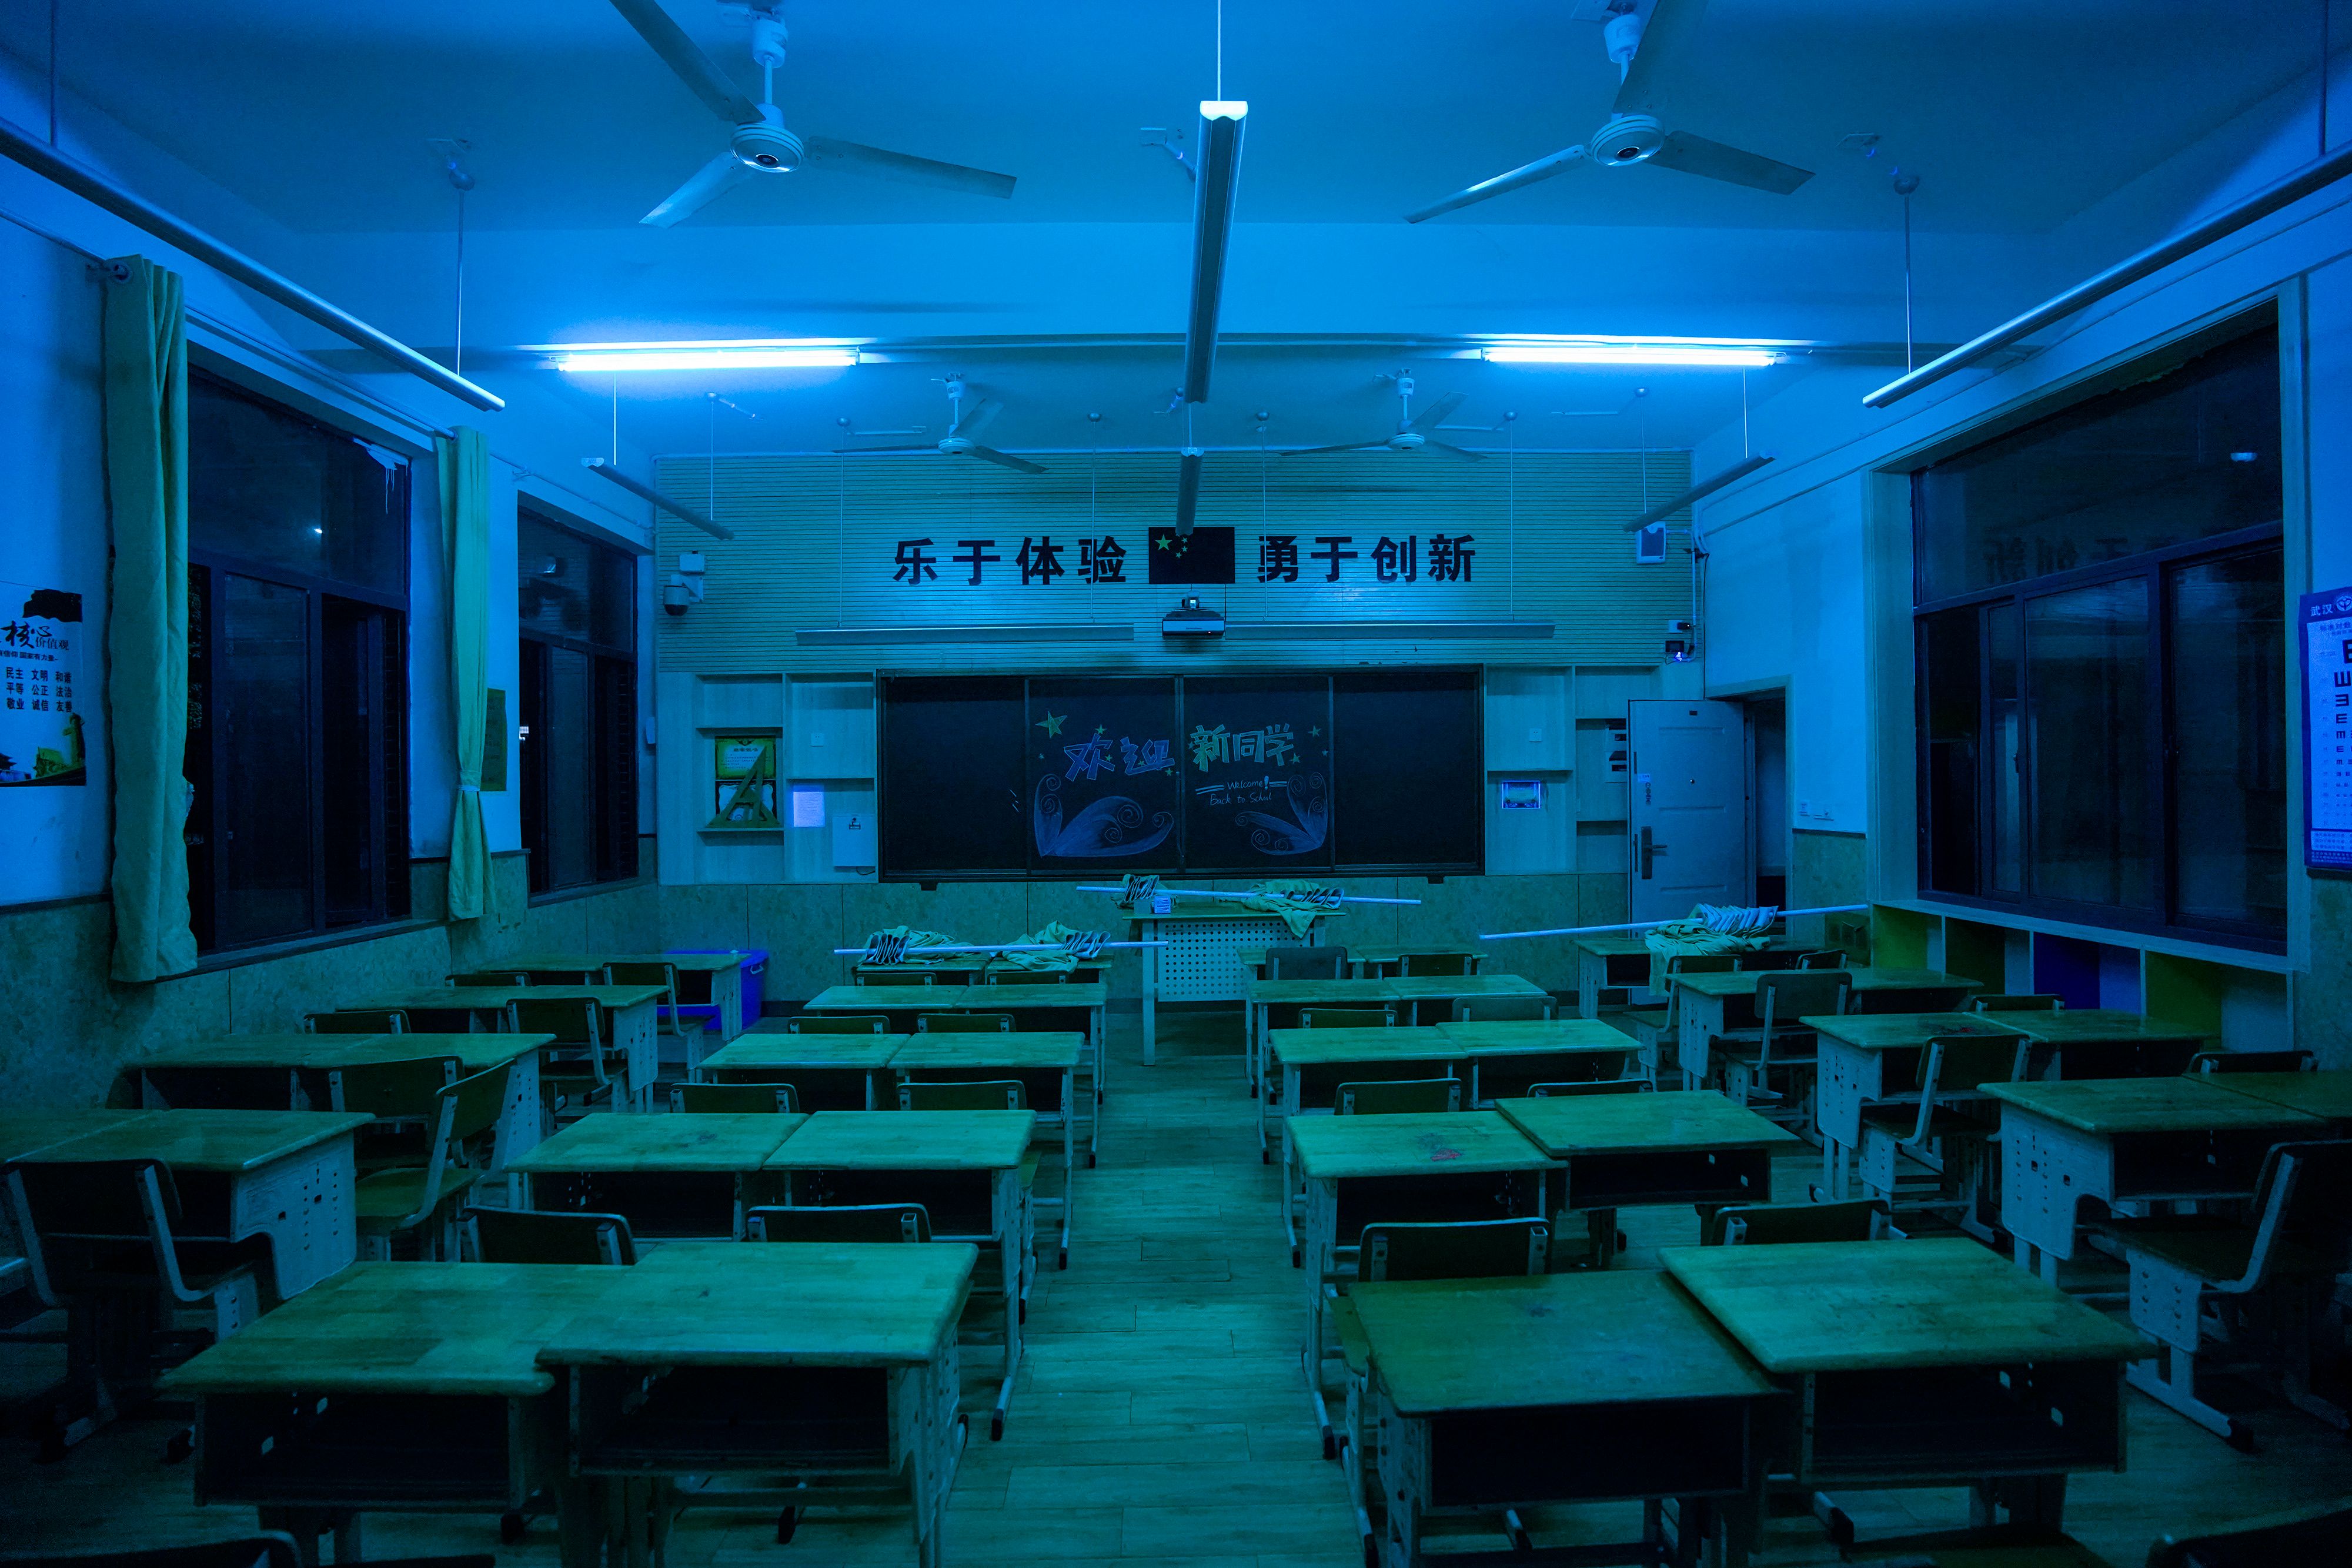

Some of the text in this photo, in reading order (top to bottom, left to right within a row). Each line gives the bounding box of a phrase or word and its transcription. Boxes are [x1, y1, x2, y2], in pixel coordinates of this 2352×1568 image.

[892, 535, 1128, 586] 乐于体验
[1257, 534, 1476, 584] 勇于创新
[2310, 604, 2334, 617] 武汉
[36, 637, 69, 651] 价值观
[6, 667, 72, 684] 民主 文明 和谐
[6, 682, 72, 698] 平等 公正 法治
[6, 697, 72, 713] 敬业 诚信 友善
[1062, 723, 1294, 781] 欢迎 新同学
[1227, 775, 1269, 791] Welcome!
[1210, 792, 1272, 805] Back to School
